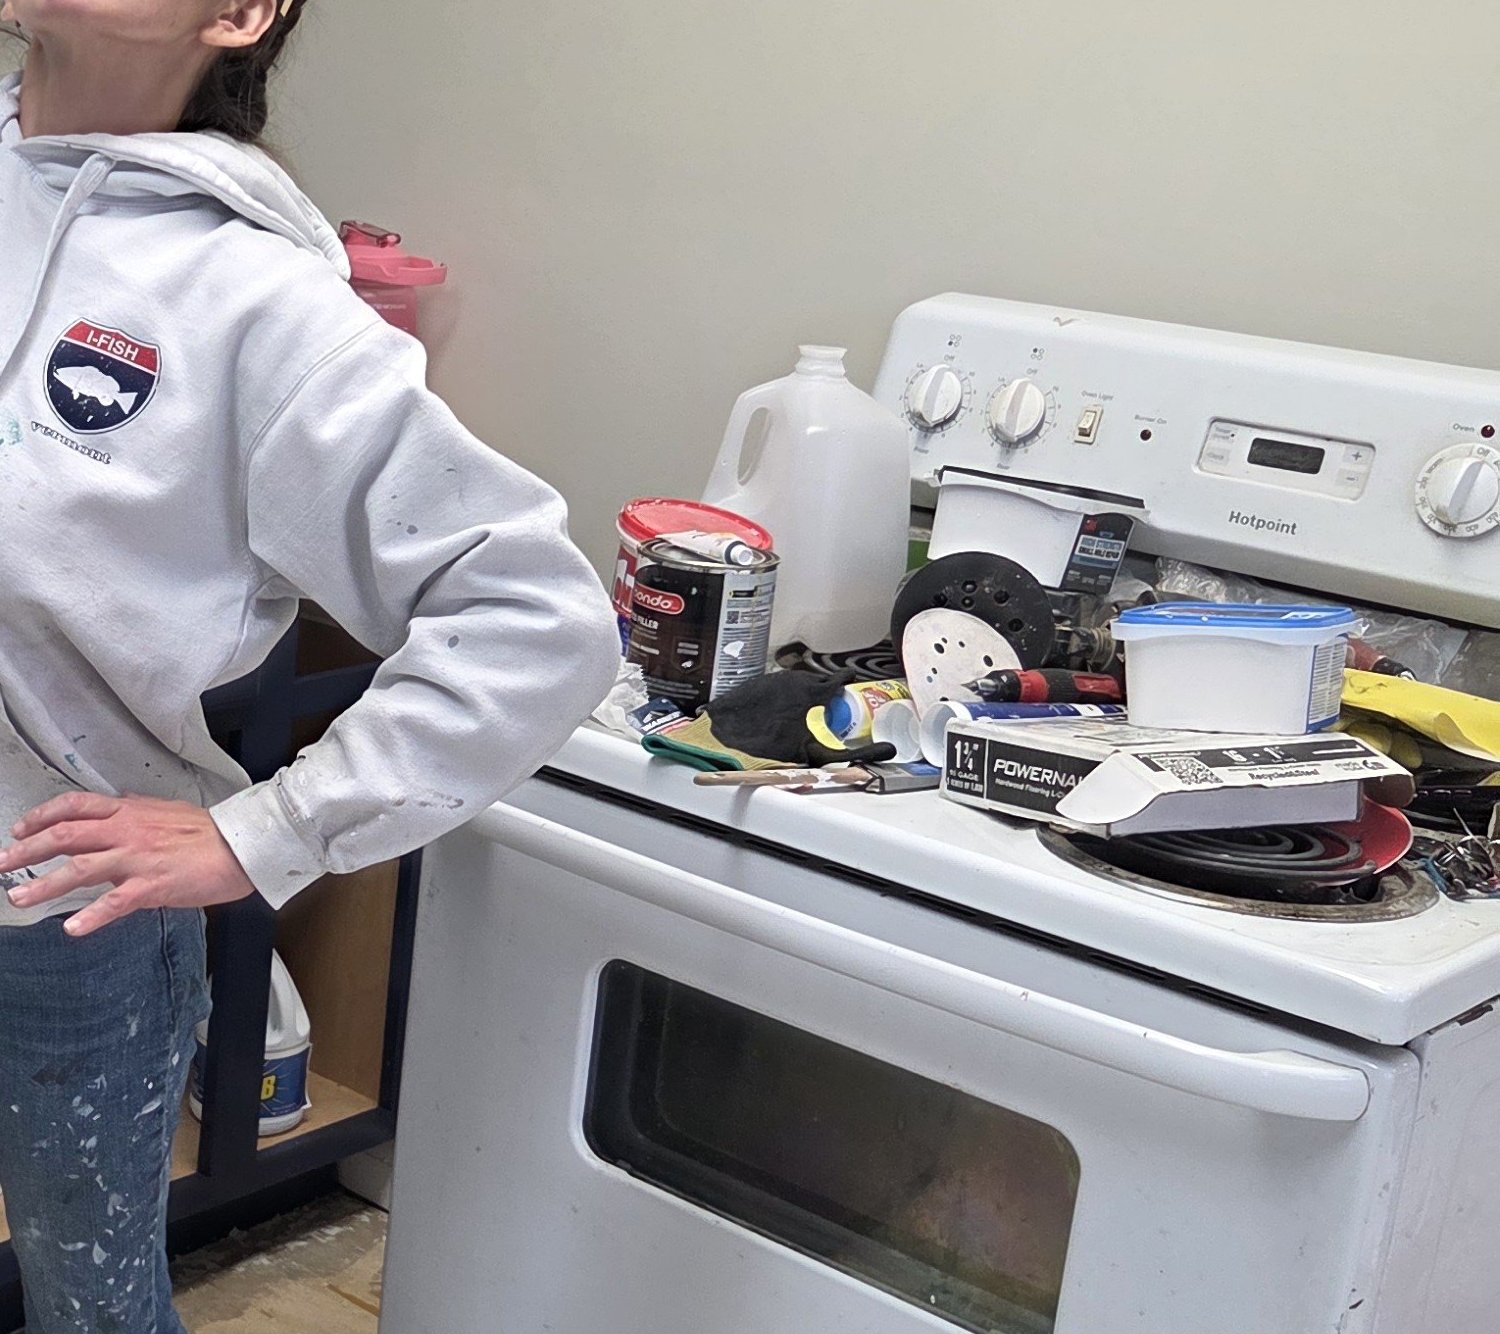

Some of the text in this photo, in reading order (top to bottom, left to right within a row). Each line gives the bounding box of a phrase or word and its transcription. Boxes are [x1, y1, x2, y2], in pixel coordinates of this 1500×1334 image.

[86, 329, 139, 361] I-FISH
[31, 420, 112, 465] vermont
[1228, 510, 1298, 535] Hotpoint
[637, 616, 659, 630] FILLER
